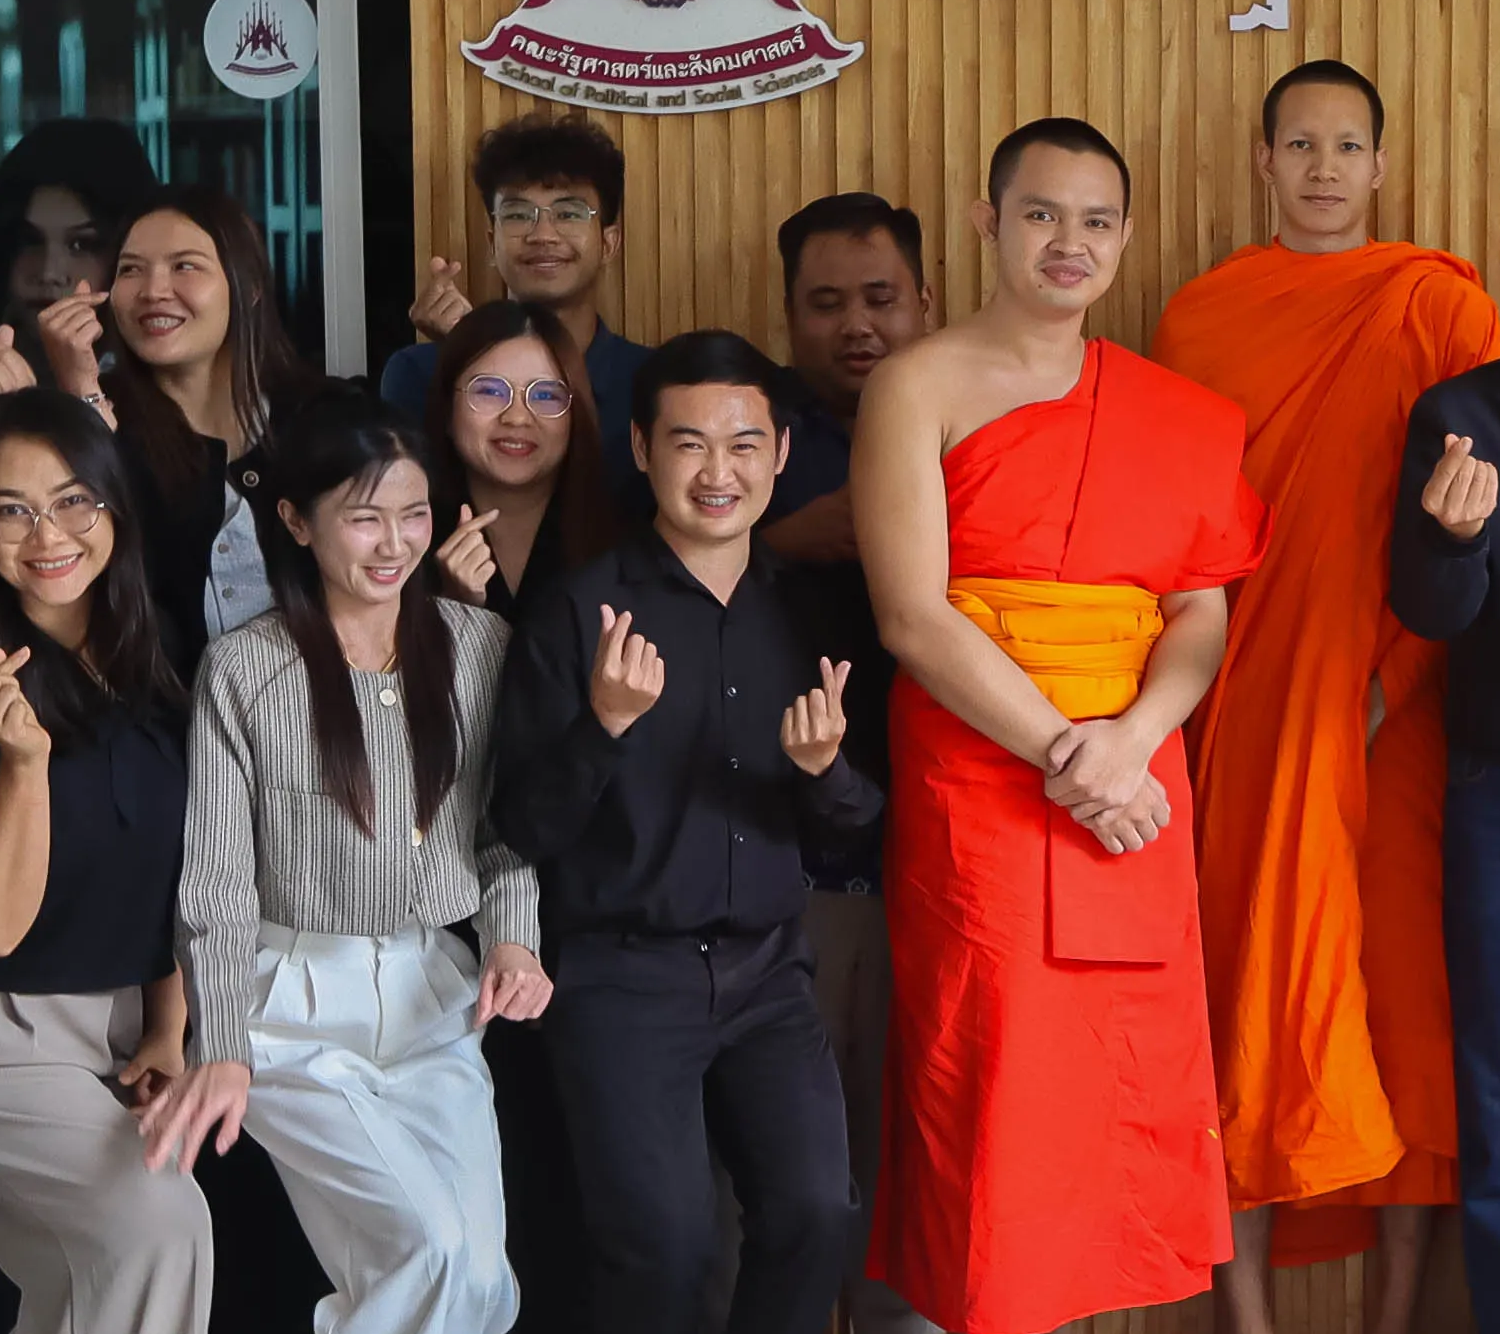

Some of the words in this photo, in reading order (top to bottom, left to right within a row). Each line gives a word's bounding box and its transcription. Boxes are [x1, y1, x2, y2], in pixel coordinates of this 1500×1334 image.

[510, 25, 806, 82] คณะรัฐศาสตร์และสังคมศาสตร์
[499, 60, 556, 92] School
[559, 82, 580, 97] of
[585, 84, 649, 108] Political
[656, 89, 686, 108] and
[753, 62, 827, 95] Sciences
